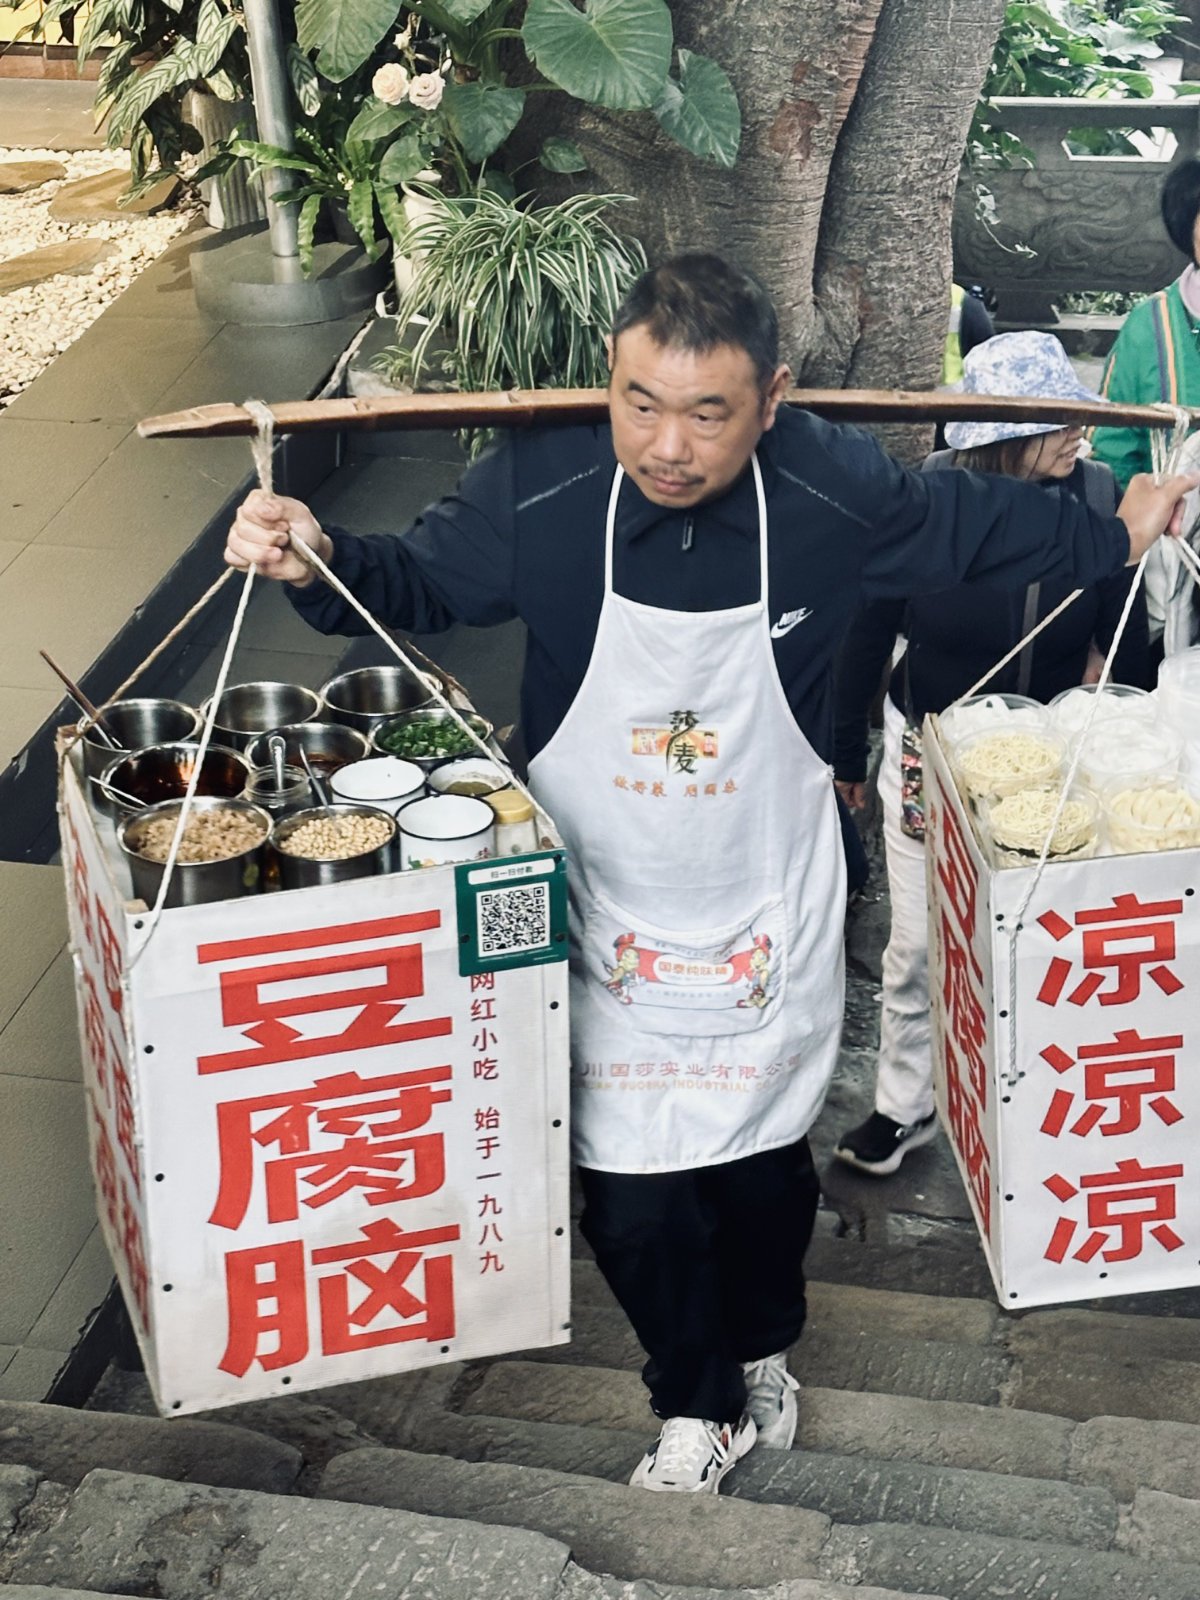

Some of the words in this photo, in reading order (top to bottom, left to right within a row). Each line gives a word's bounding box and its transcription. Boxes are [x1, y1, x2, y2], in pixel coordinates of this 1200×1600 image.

[778, 607, 806, 626] NIKE
[470, 972, 499, 1080] 网红小吃
[935, 769, 991, 1247] 豆腐脑
[1036, 893, 1184, 1264] 凉凉凉
[196, 909, 462, 1379] 豆腐脑
[474, 1106, 504, 1275] 始于一九八九
